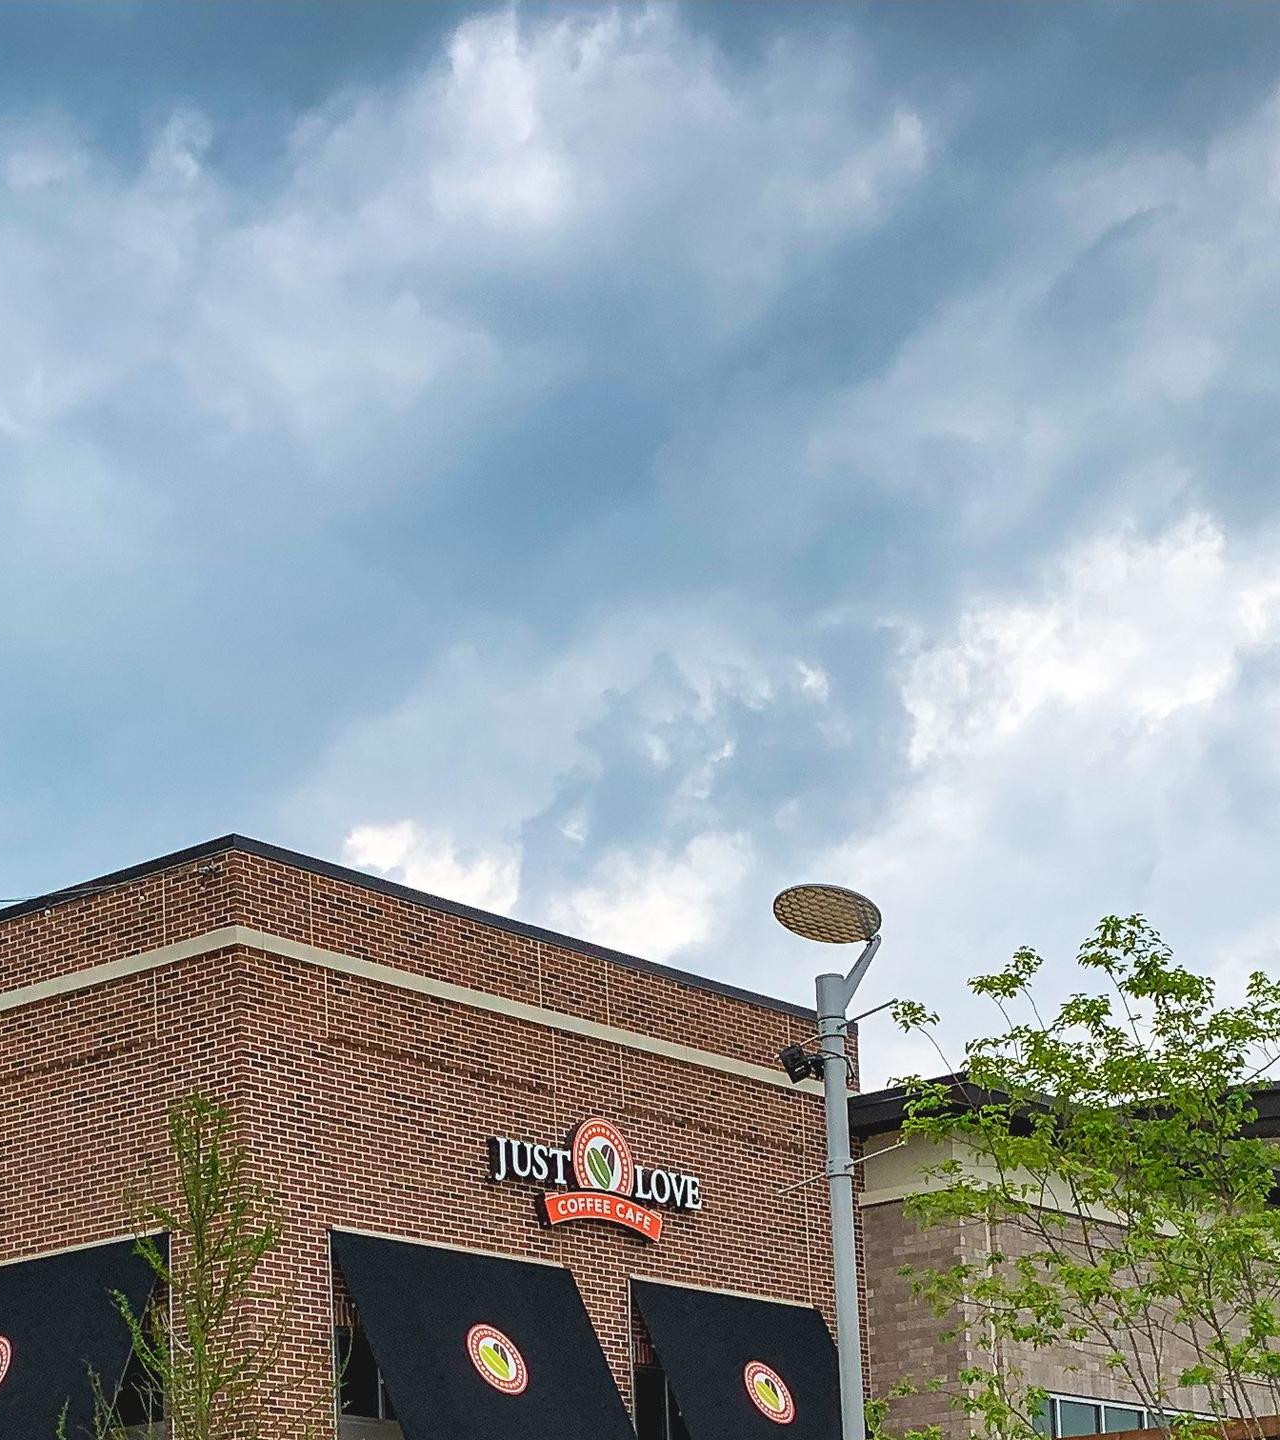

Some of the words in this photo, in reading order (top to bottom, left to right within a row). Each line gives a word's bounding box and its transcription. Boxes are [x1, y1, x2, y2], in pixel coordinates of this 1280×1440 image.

[495, 1137, 570, 1184] JUST
[634, 1165, 702, 1209] LOVE
[557, 1198, 611, 1215] COFFEE
[615, 1203, 651, 1231] CAFE
